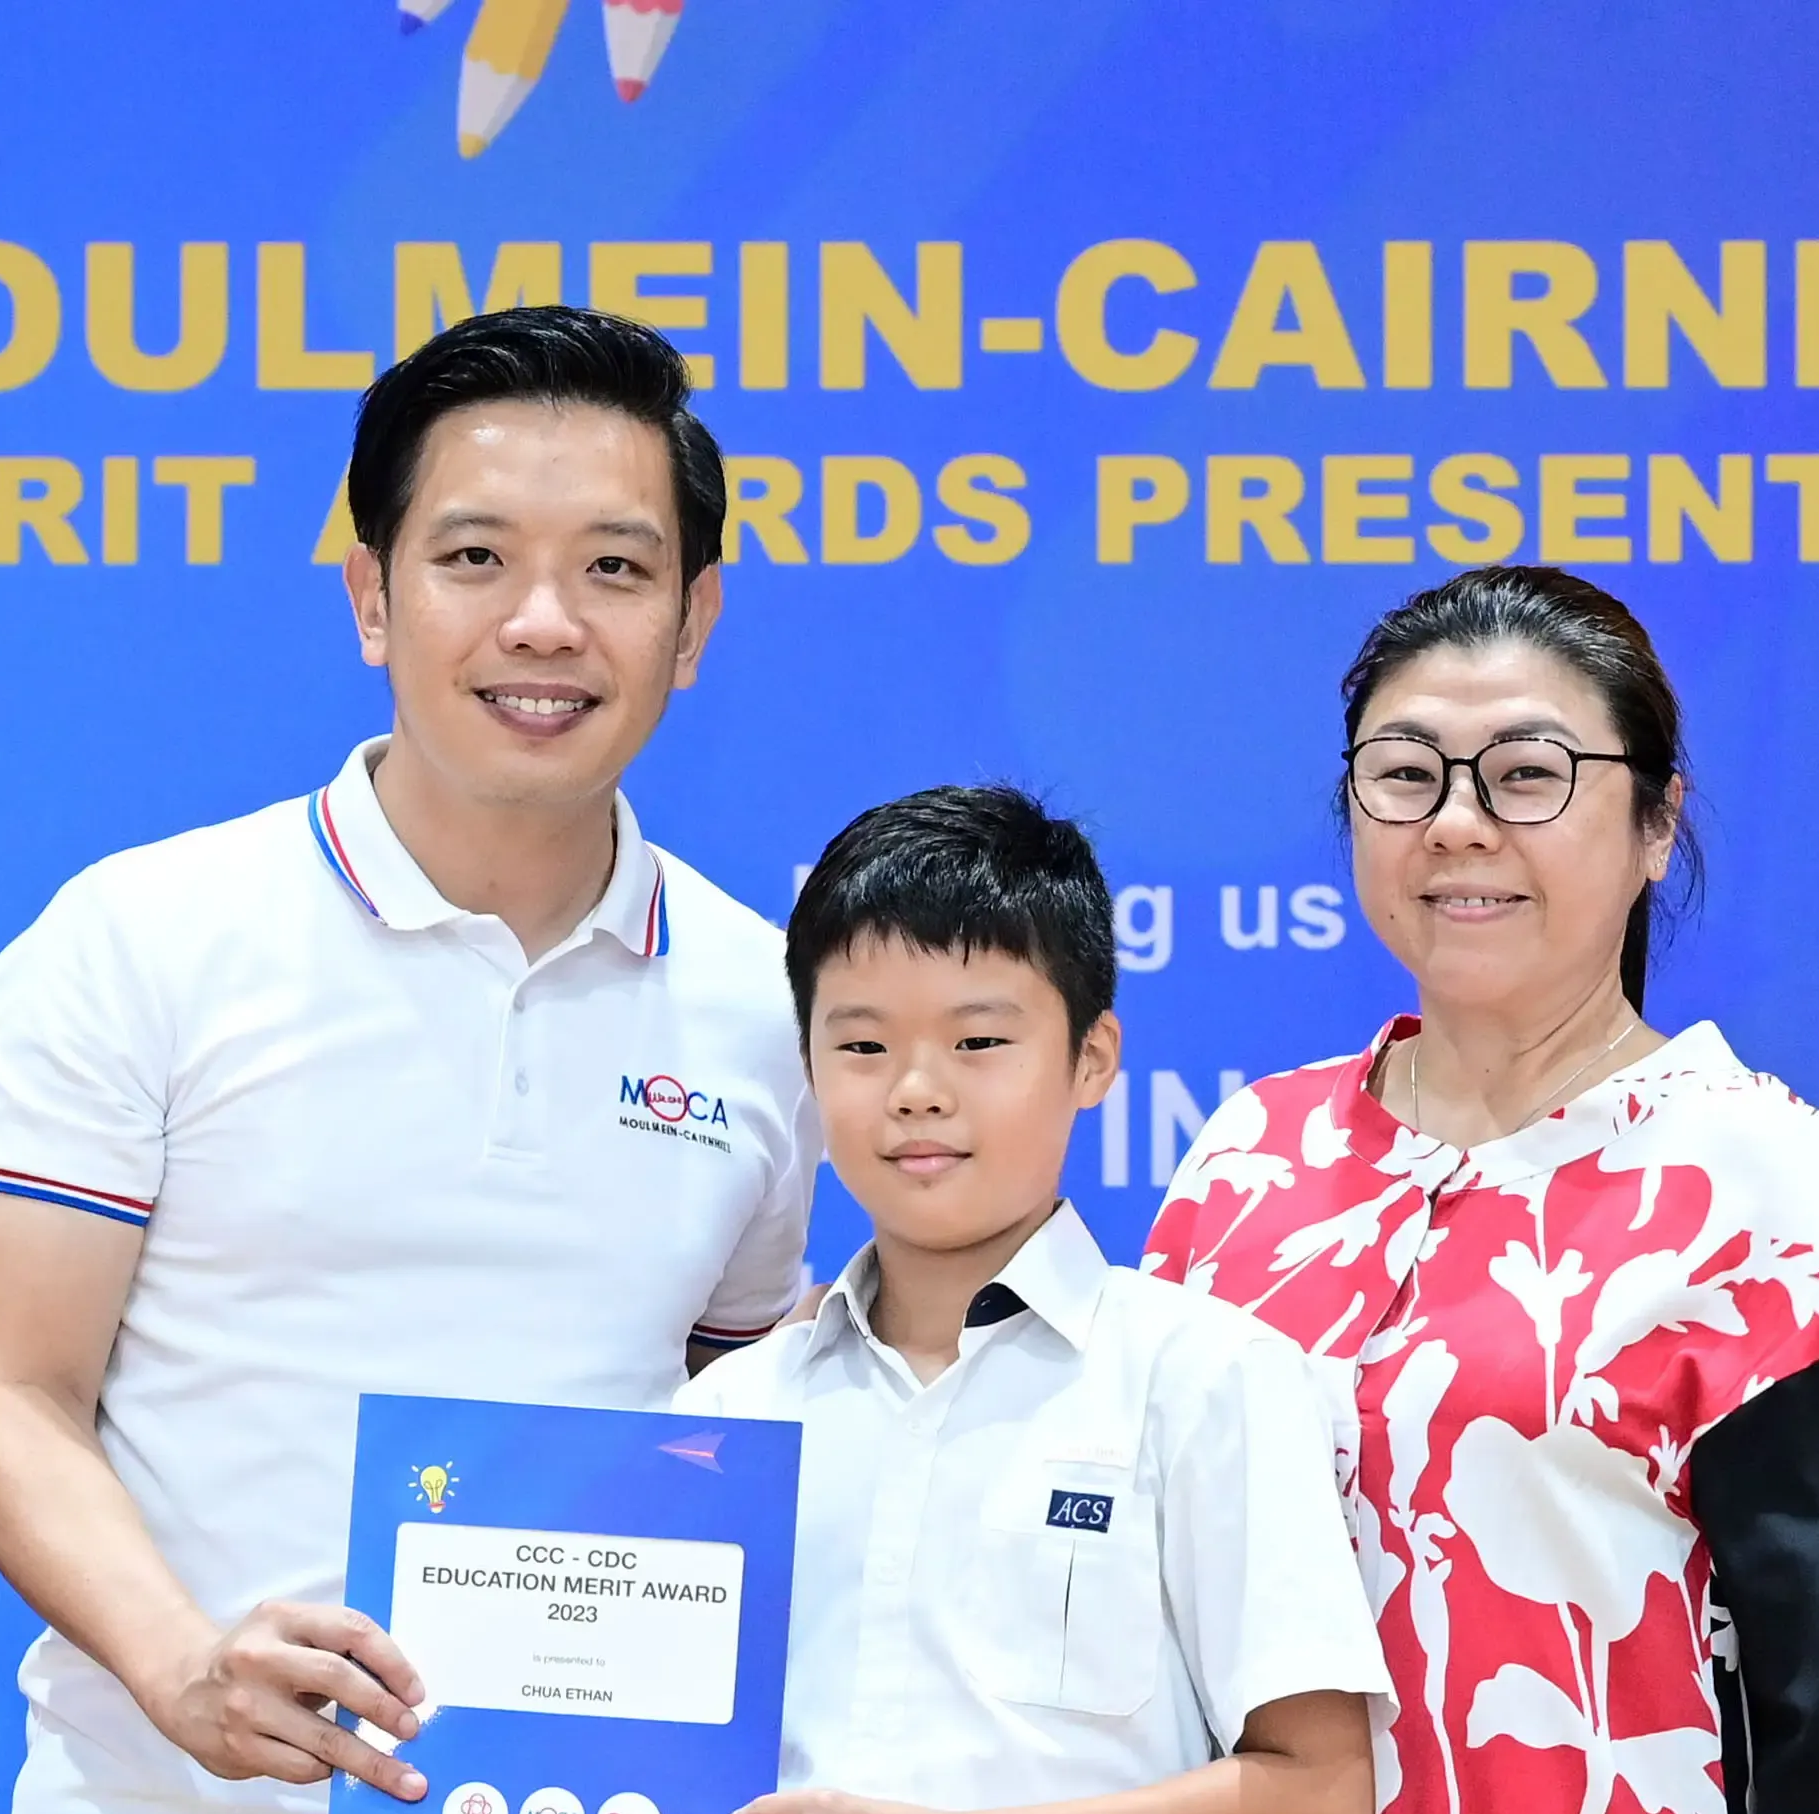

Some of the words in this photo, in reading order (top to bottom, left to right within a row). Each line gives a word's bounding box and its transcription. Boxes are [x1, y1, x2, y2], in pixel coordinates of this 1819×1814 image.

[312, 453, 1031, 565] RDS
[1219, 884, 1346, 950] us
[619, 1074, 729, 1130] MOCA
[619, 1115, 732, 1154] MOULMEIN-CAIRNHILL
[1051, 1496, 1107, 1525] ACS
[516, 1544, 565, 1565] CCC
[587, 1549, 638, 1570] CDC
[422, 1566, 557, 1592] EDUCATION
[563, 1575, 636, 1597] MERIT
[641, 1581, 728, 1604] AWARD
[547, 1603, 598, 1623] 2023
[521, 1684, 562, 1699] CHUA
[565, 1687, 613, 1702] ETHAN
